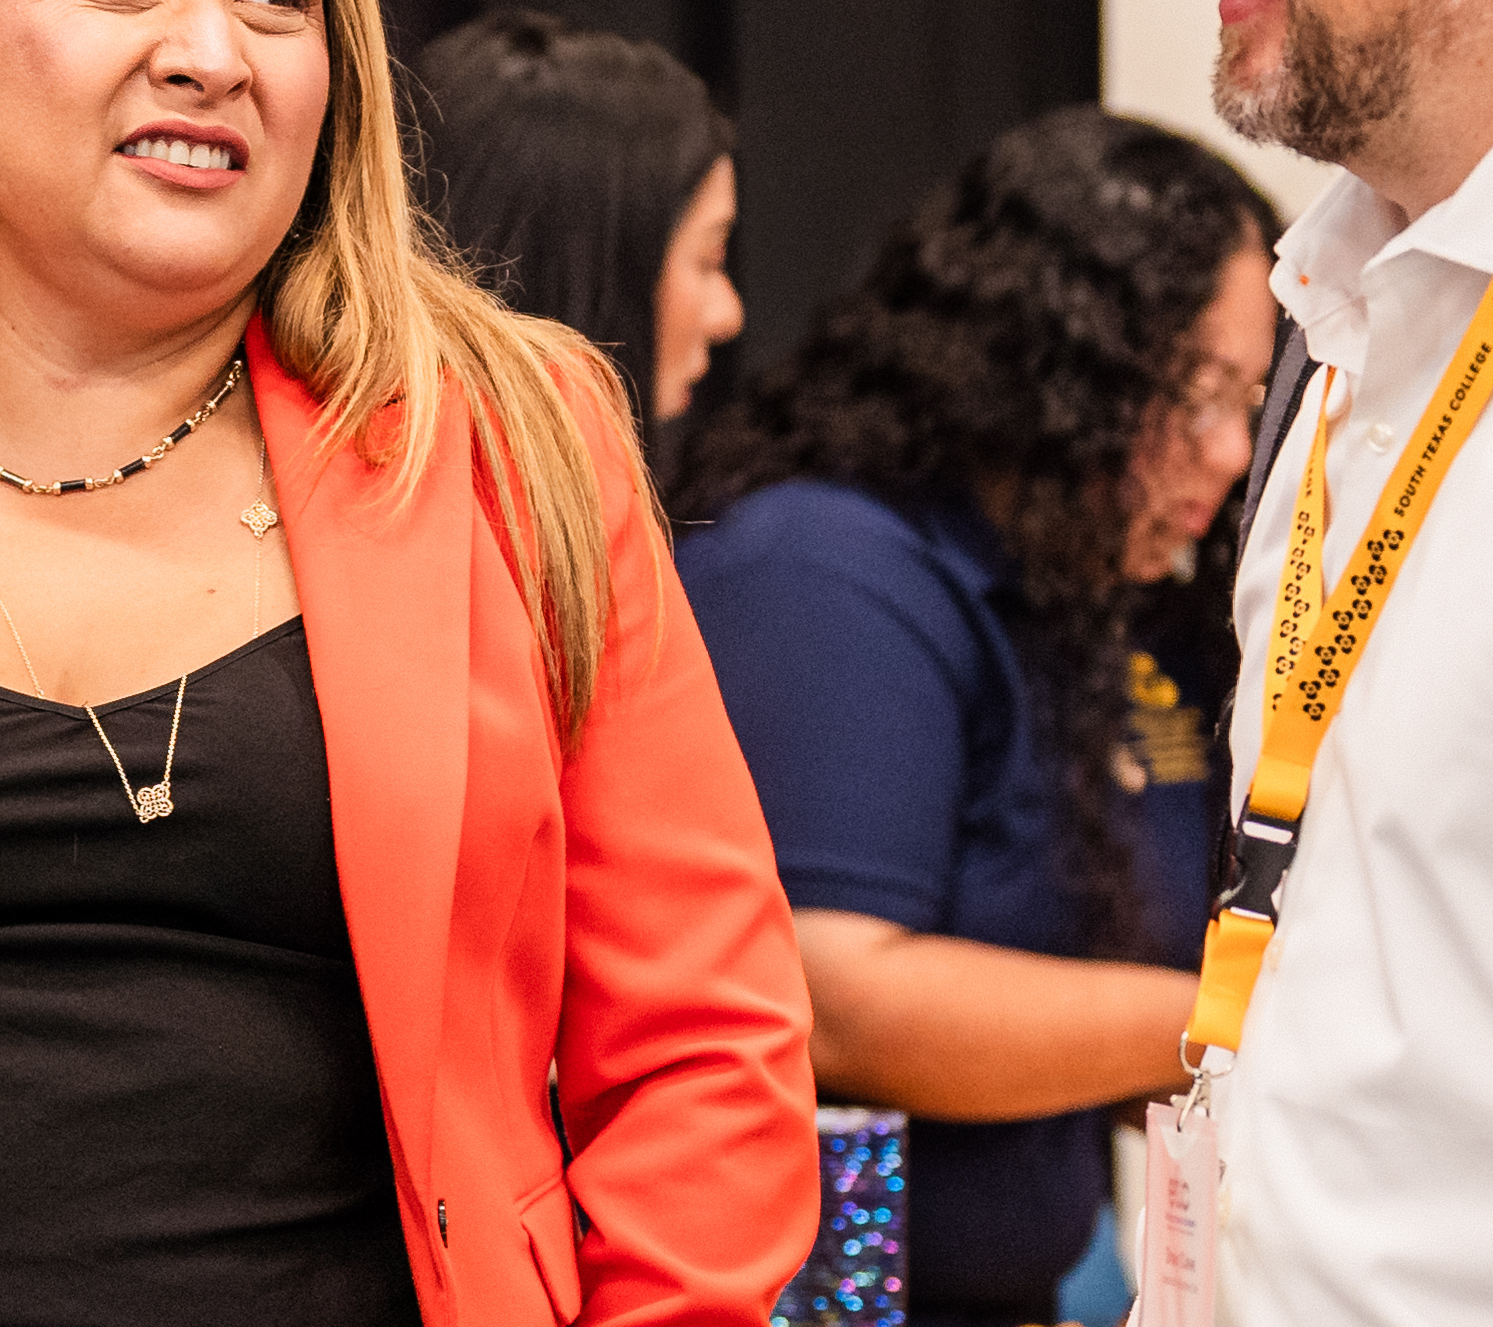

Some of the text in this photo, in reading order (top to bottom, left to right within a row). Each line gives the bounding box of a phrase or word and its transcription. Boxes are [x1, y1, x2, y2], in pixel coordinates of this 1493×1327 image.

[1393, 341, 1493, 518] SOUTH TEXAS COLLEGE
